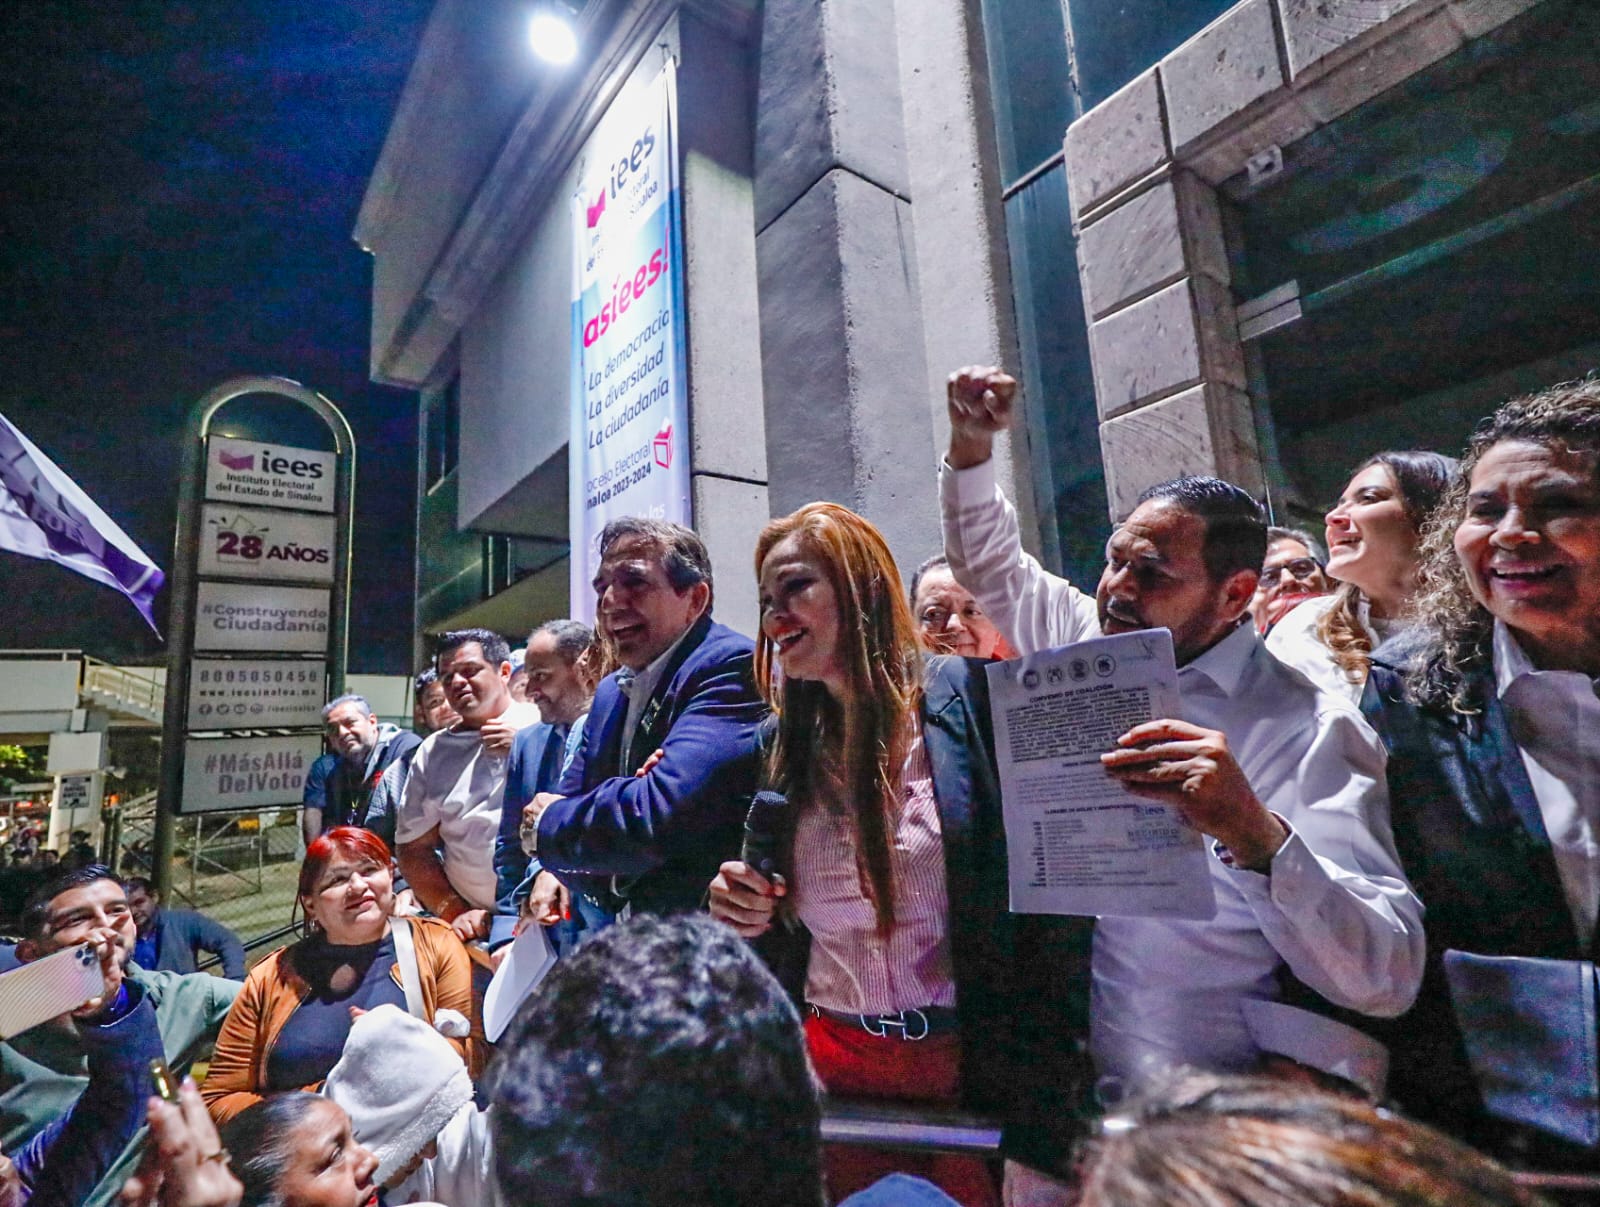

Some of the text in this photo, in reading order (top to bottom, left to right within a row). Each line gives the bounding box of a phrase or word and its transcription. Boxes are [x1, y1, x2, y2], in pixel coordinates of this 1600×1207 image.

[610, 126, 656, 199] iees
[583, 225, 670, 348] asíees!
[588, 309, 670, 391] La democracia
[588, 342, 665, 420] La diversidad
[588, 377, 669, 449] La ciudadanía
[262, 450, 322, 478] iees
[615, 440, 651, 477] Electoral
[216, 482, 323, 502] del Estado de Sinaloa
[226, 473, 314, 490] Instituto Electoral
[586, 462, 652, 510] naloa 2023-2024
[216, 531, 329, 563] 28 AÑOS
[202, 604, 327, 621] #Construyendo
[213, 616, 327, 633] Ciudadanía
[204, 749, 303, 774] #MásAllá
[218, 773, 302, 794] DelVoto
